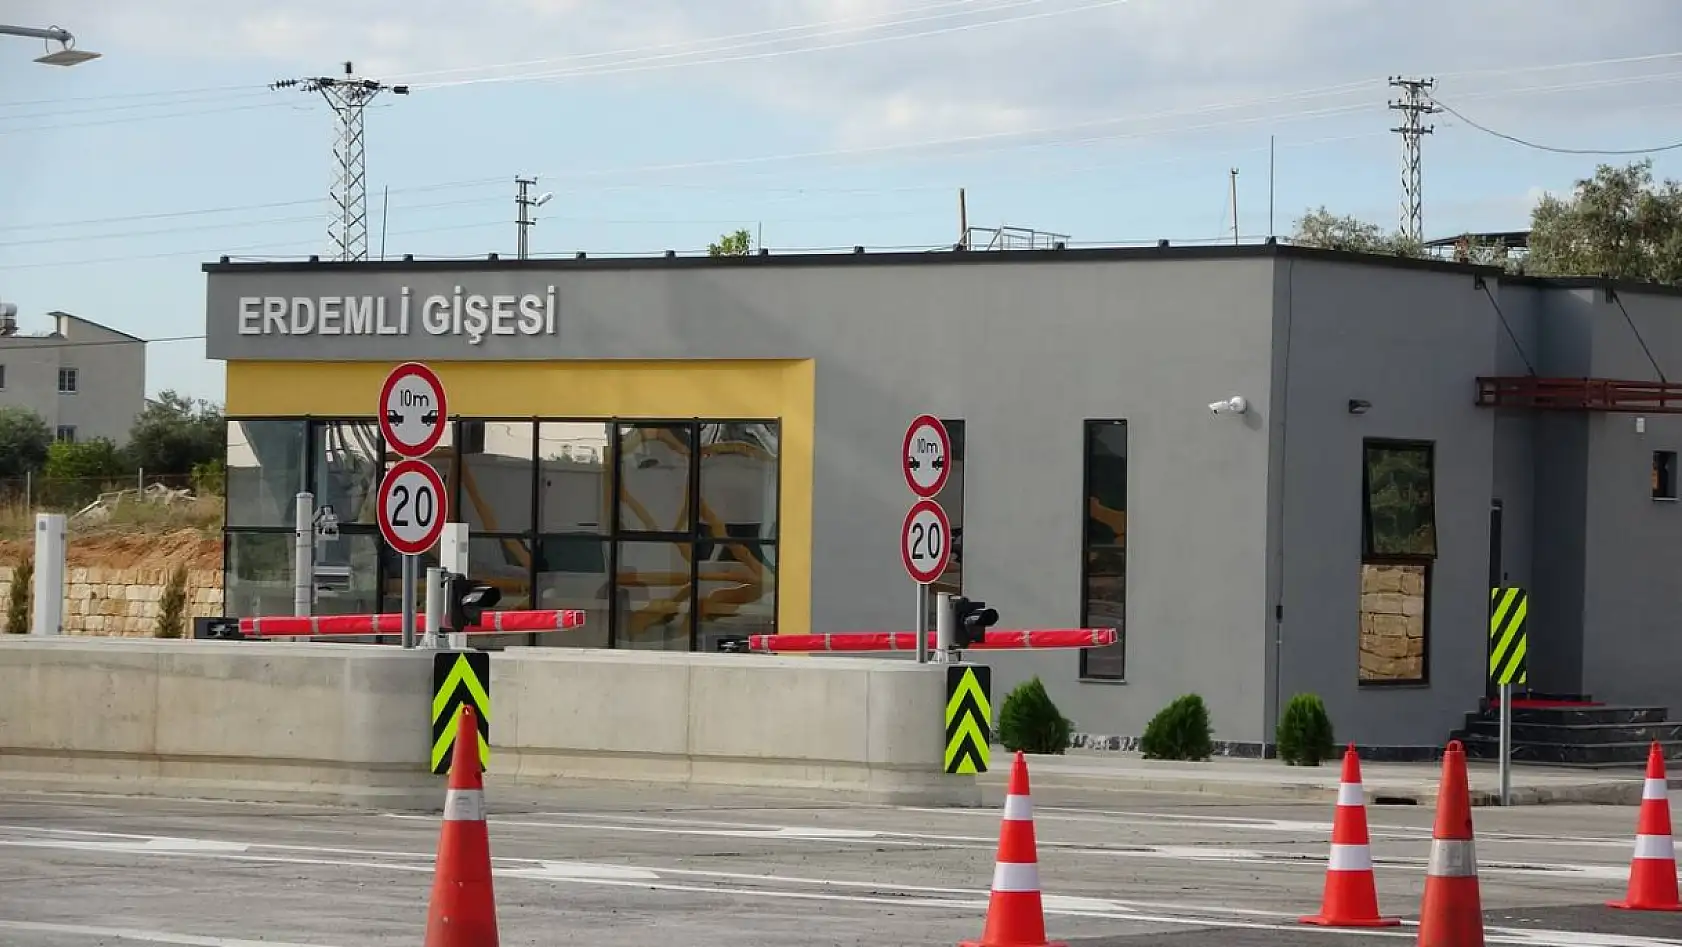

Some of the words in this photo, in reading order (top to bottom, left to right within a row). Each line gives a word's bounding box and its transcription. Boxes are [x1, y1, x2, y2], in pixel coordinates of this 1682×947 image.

[238, 286, 410, 335] ERDEMLİ
[422, 285, 556, 344] GİŞESİ
[400, 389, 429, 407] 10m
[916, 438, 938, 454] 10m
[391, 485, 432, 527] 20
[911, 522, 940, 560] 20
